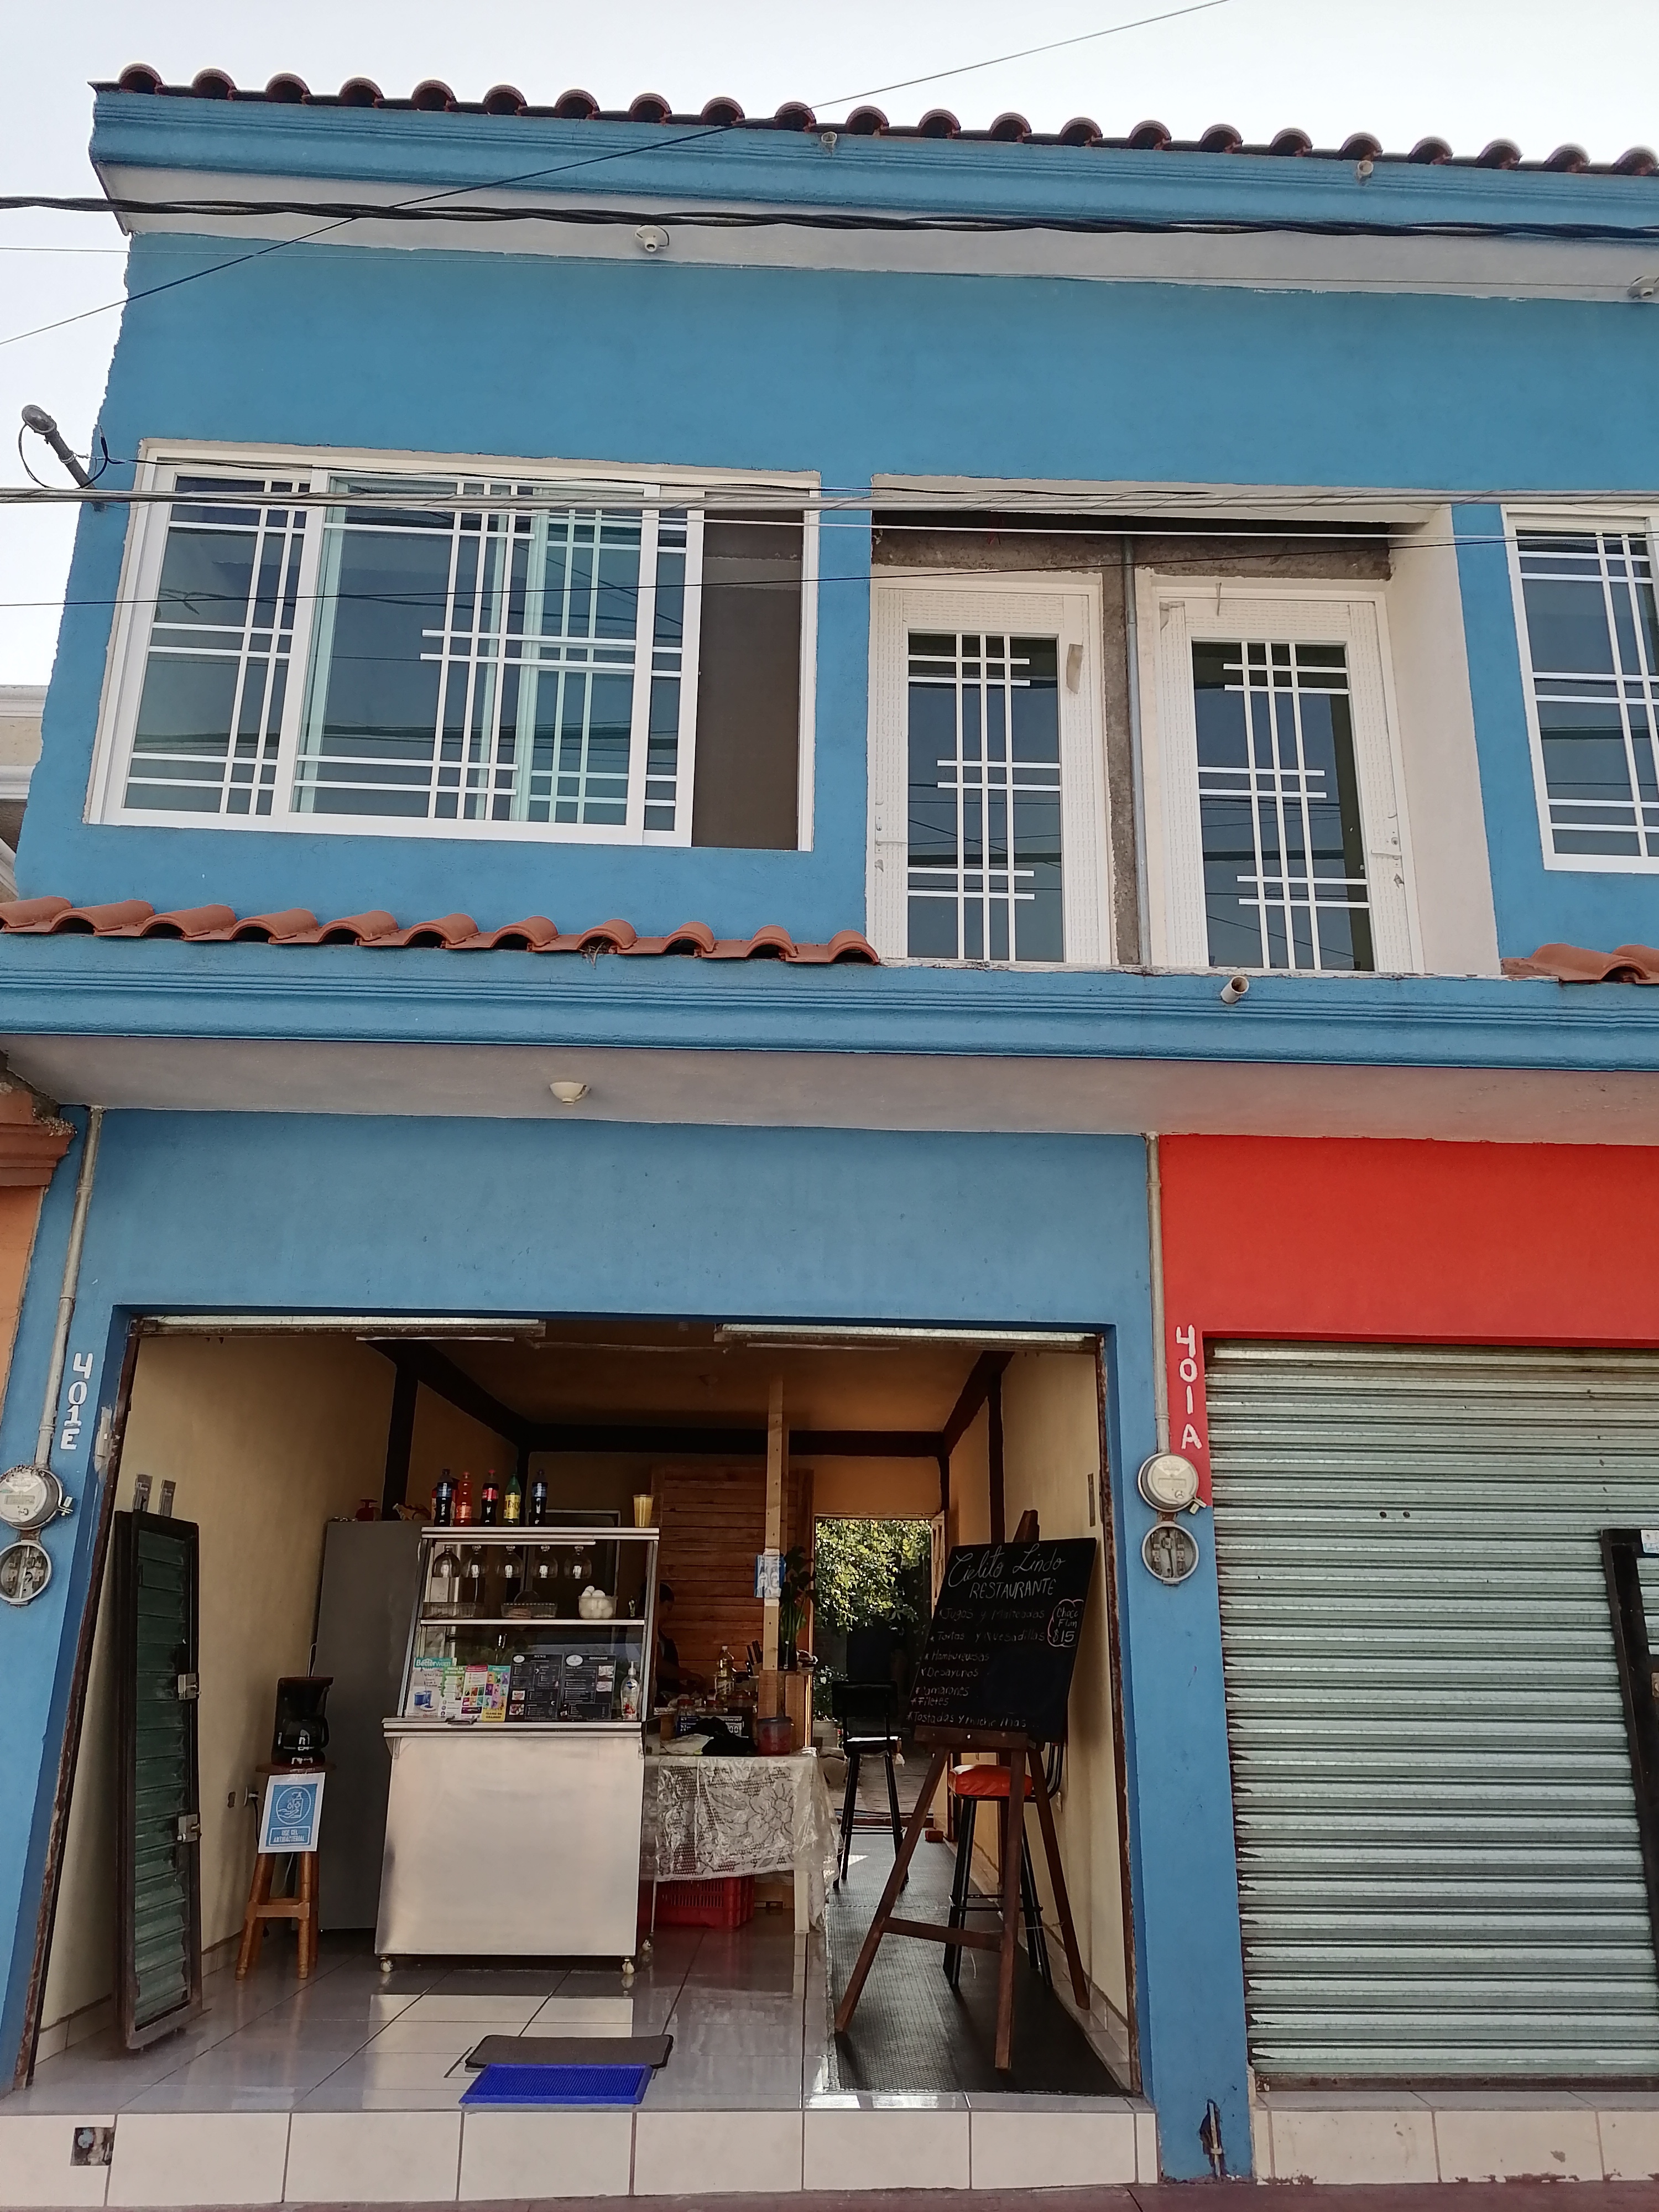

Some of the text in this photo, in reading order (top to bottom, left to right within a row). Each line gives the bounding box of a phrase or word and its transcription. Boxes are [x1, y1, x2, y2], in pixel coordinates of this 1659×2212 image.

[948, 1543, 1066, 1587] Cielito Lindo
[969, 1578, 1057, 1599] RESTAURANTE
[940, 1608, 973, 1621] Jugos
[1058, 1619, 1077, 1629] Flan
[1052, 1628, 1076, 1643] $15
[917, 1697, 949, 1706] Filetes
[913, 1711, 954, 1724] Tostadas
